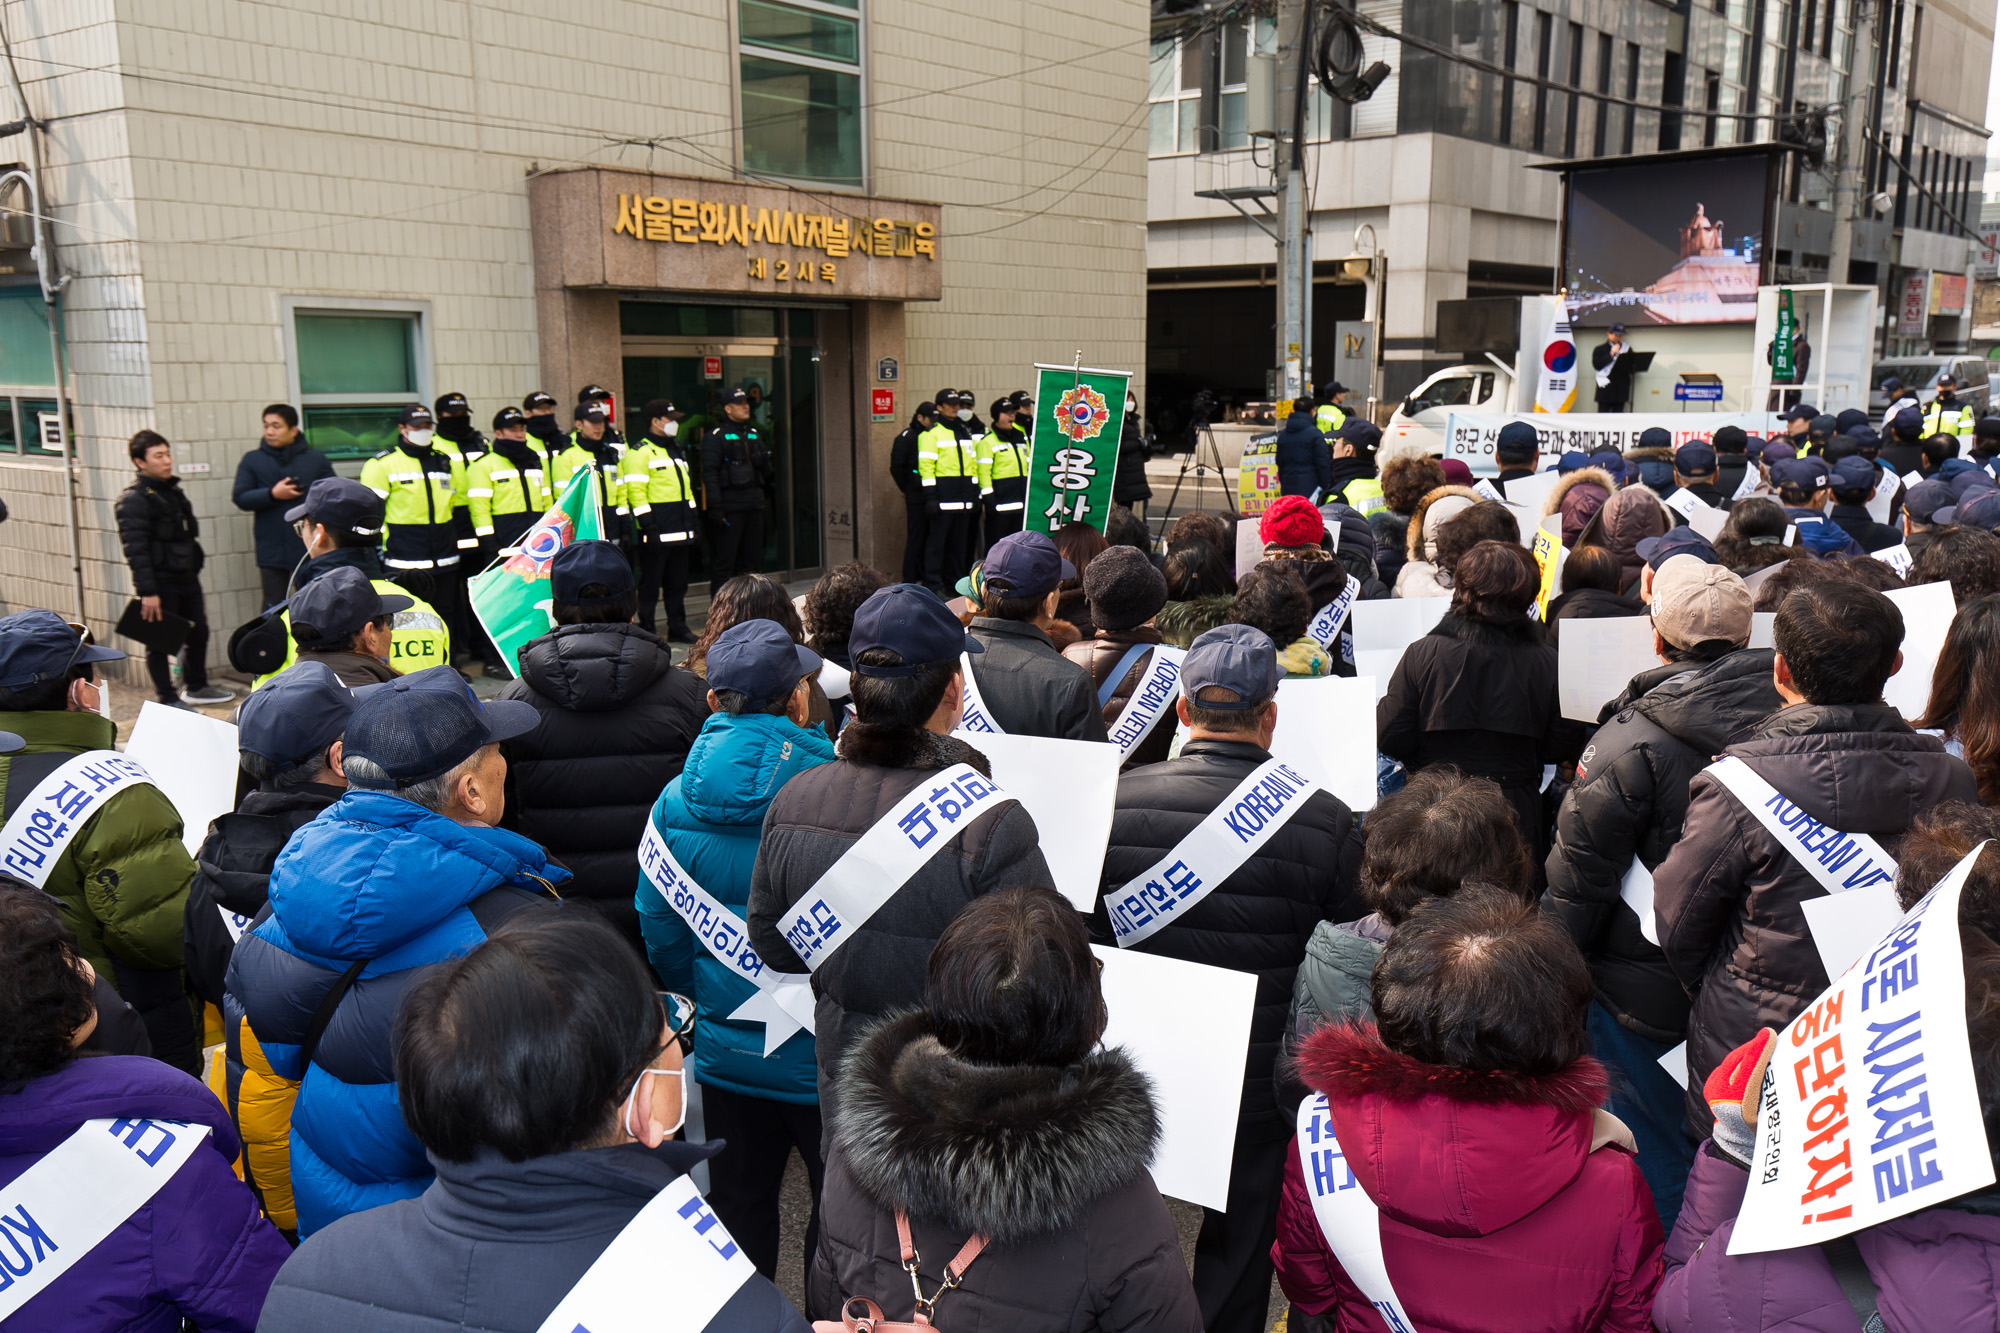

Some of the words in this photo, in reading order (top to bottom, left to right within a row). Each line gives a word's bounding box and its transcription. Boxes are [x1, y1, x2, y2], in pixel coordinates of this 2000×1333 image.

[1905, 278, 1923, 321] 부동산
[885, 368, 893, 378] 5
[1455, 427, 1479, 454] 향군
[392, 640, 435, 658] ICE
[1138, 657, 1180, 714] KOREAN
[1223, 772, 1297, 844] KOREAN
[1765, 793, 1864, 874] KOREAN
[1762, 1063, 1781, 1186] 국재향군인회
[1791, 989, 1853, 1225] 중단하자!
[1862, 1010, 1944, 1204] 시사저널
